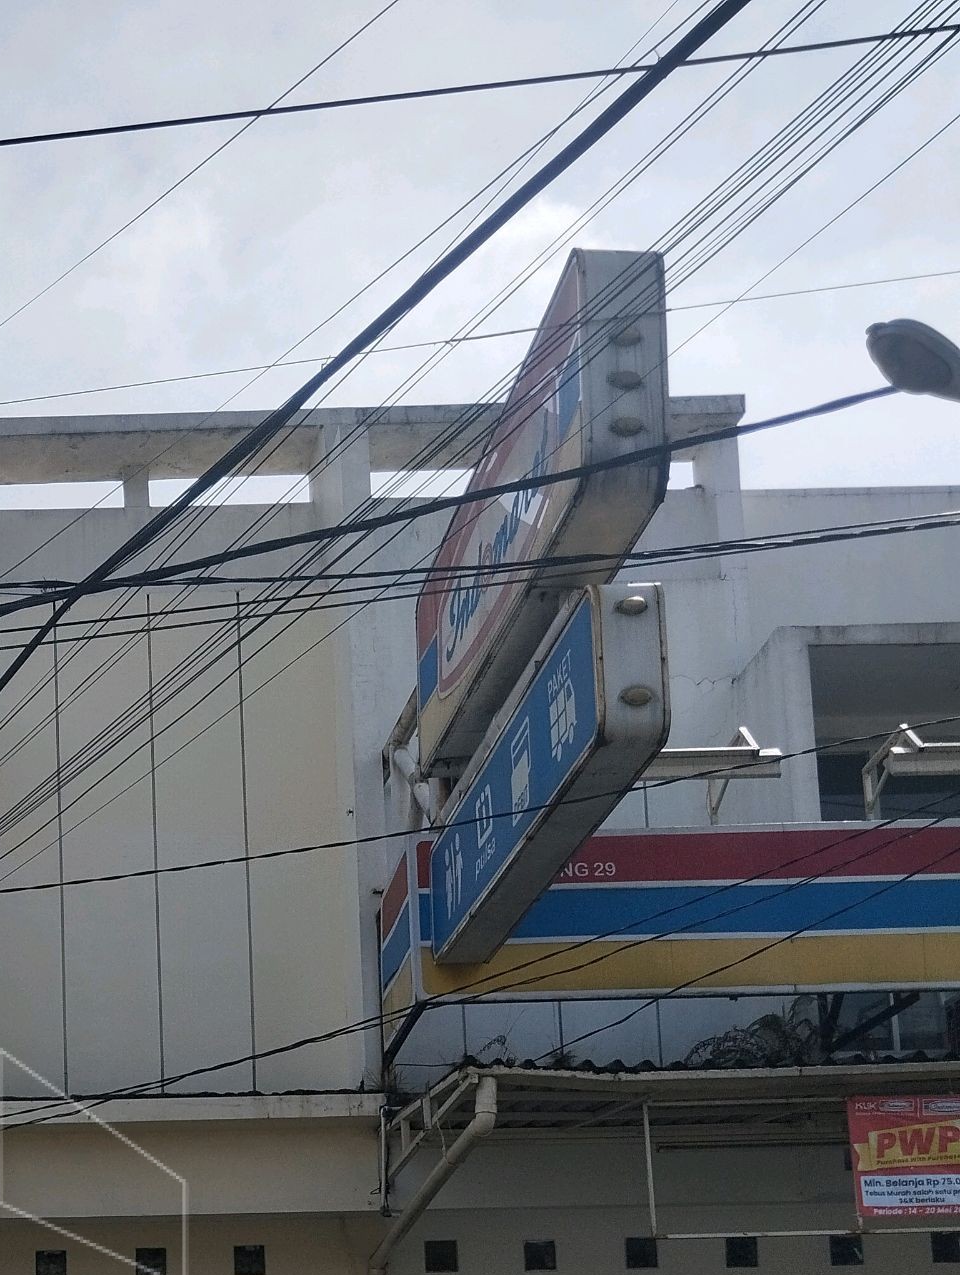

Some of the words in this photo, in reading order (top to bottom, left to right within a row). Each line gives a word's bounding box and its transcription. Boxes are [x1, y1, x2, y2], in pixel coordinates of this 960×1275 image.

[547, 649, 572, 701] PAKET
[475, 837, 496, 881] pulsa
[593, 861, 616, 877] 29
[876, 1126, 960, 1158] PWP
[864, 1179, 884, 1188] Min.
[886, 1178, 925, 1188] Belanja
[926, 1178, 940, 1188] Rp
[887, 1189, 911, 1197] Murah
[873, 1207, 903, 1215] Periode
[908, 1207, 917, 1215] 14
